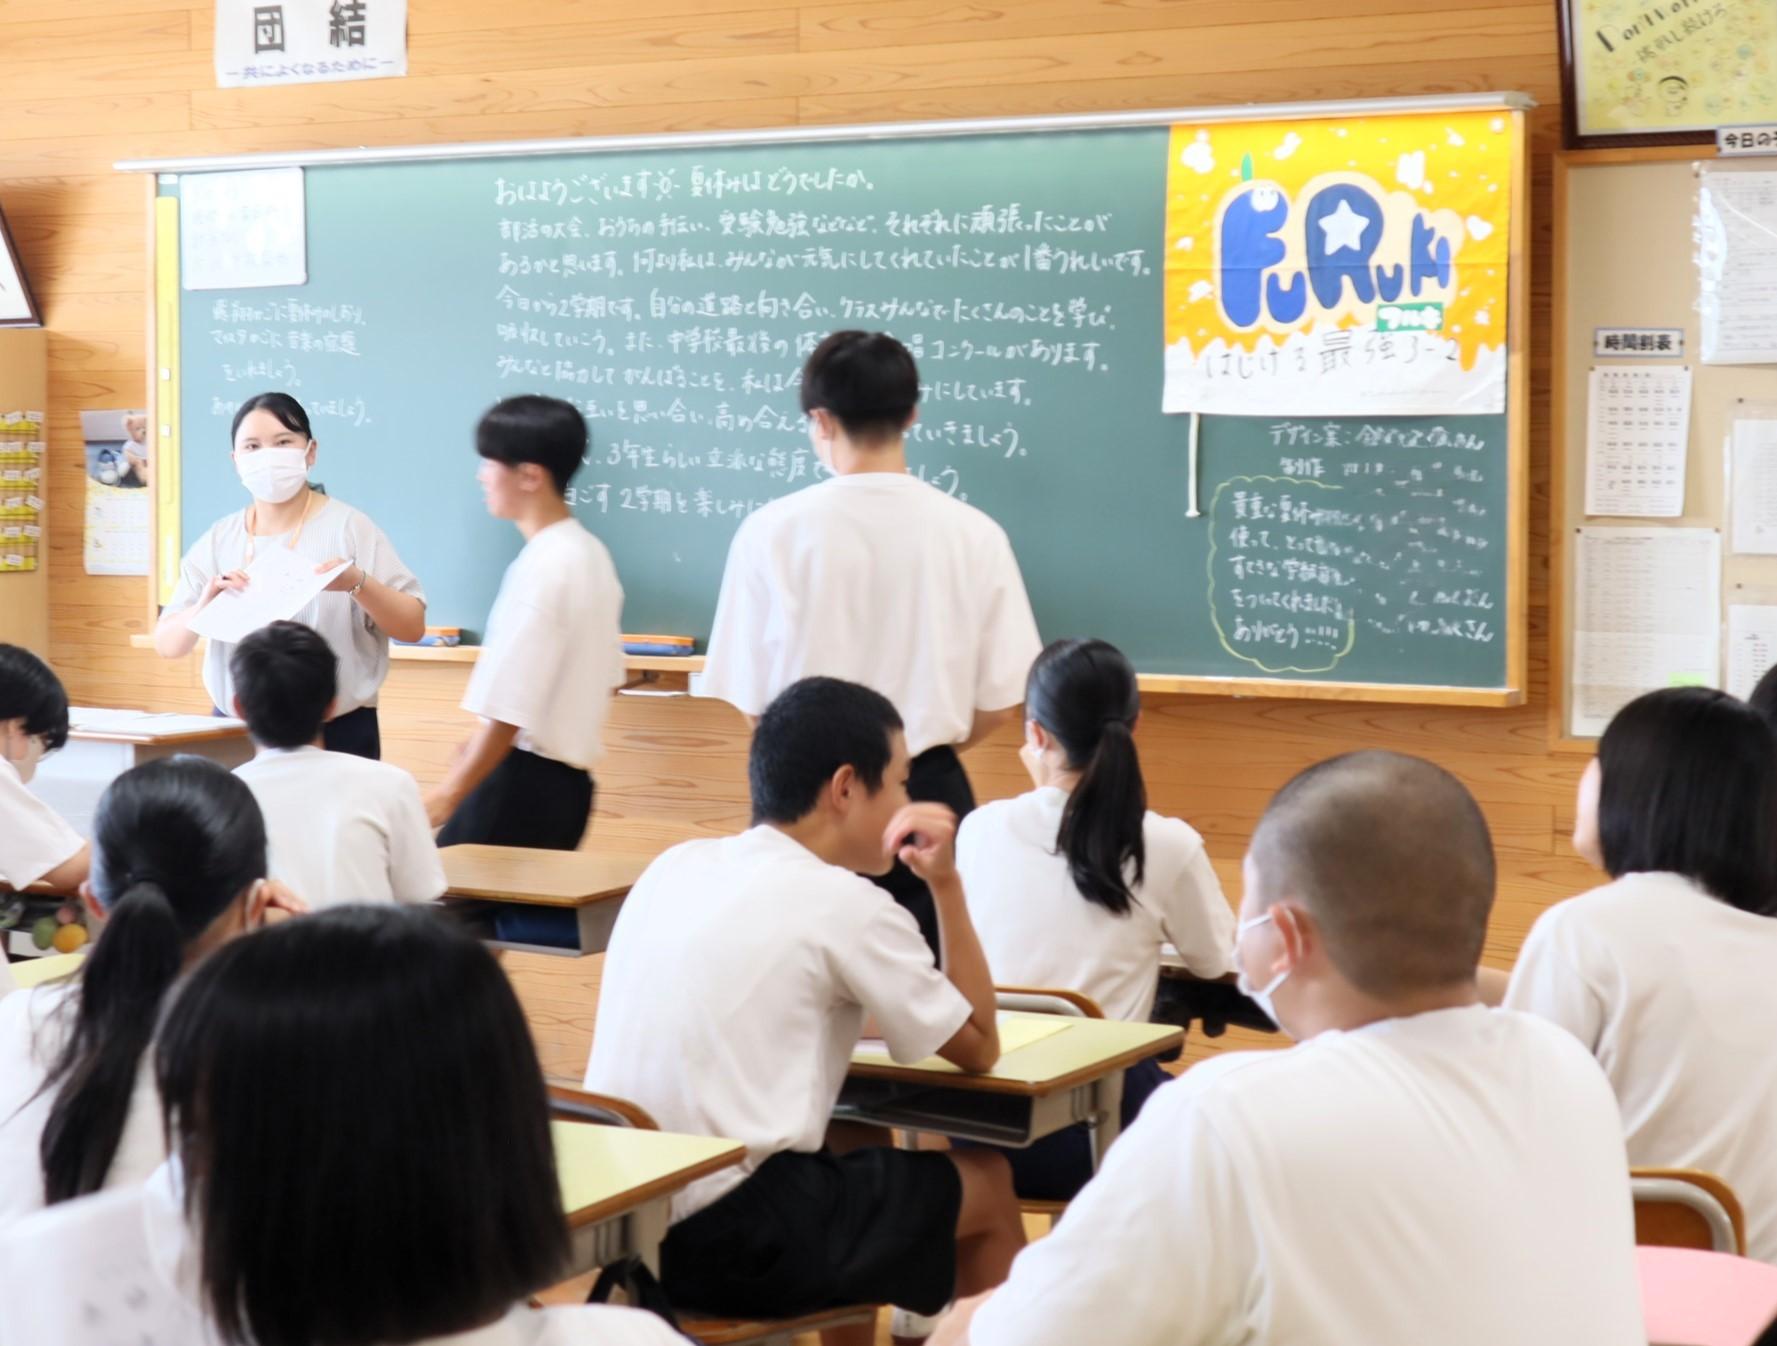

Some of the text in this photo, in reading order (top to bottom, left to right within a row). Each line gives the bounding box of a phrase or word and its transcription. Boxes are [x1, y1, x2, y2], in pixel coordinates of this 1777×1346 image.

[886, 332, 1109, 372] 唱コンクールがあります。
[1605, 334, 1671, 351] 時間割表
